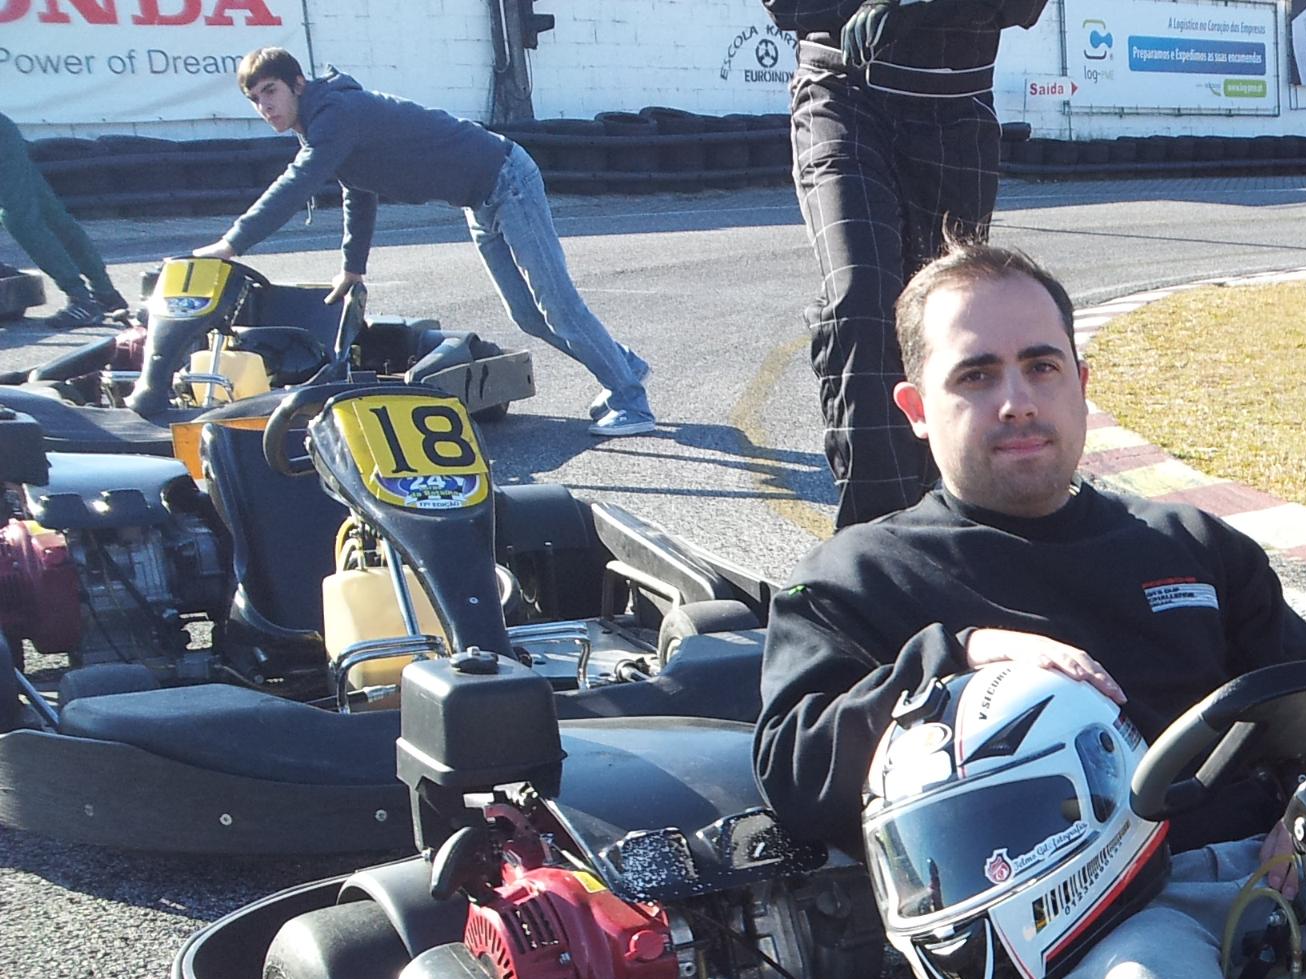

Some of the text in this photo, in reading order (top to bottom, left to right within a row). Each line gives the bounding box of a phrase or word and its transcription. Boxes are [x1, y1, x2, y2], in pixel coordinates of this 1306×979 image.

[107, 49, 136, 75] of
[150, 49, 243, 75] Dream
[720, 24, 798, 80] ESCOLA KART
[744, 69, 795, 82] EUROINDY
[369, 405, 476, 473] 18
